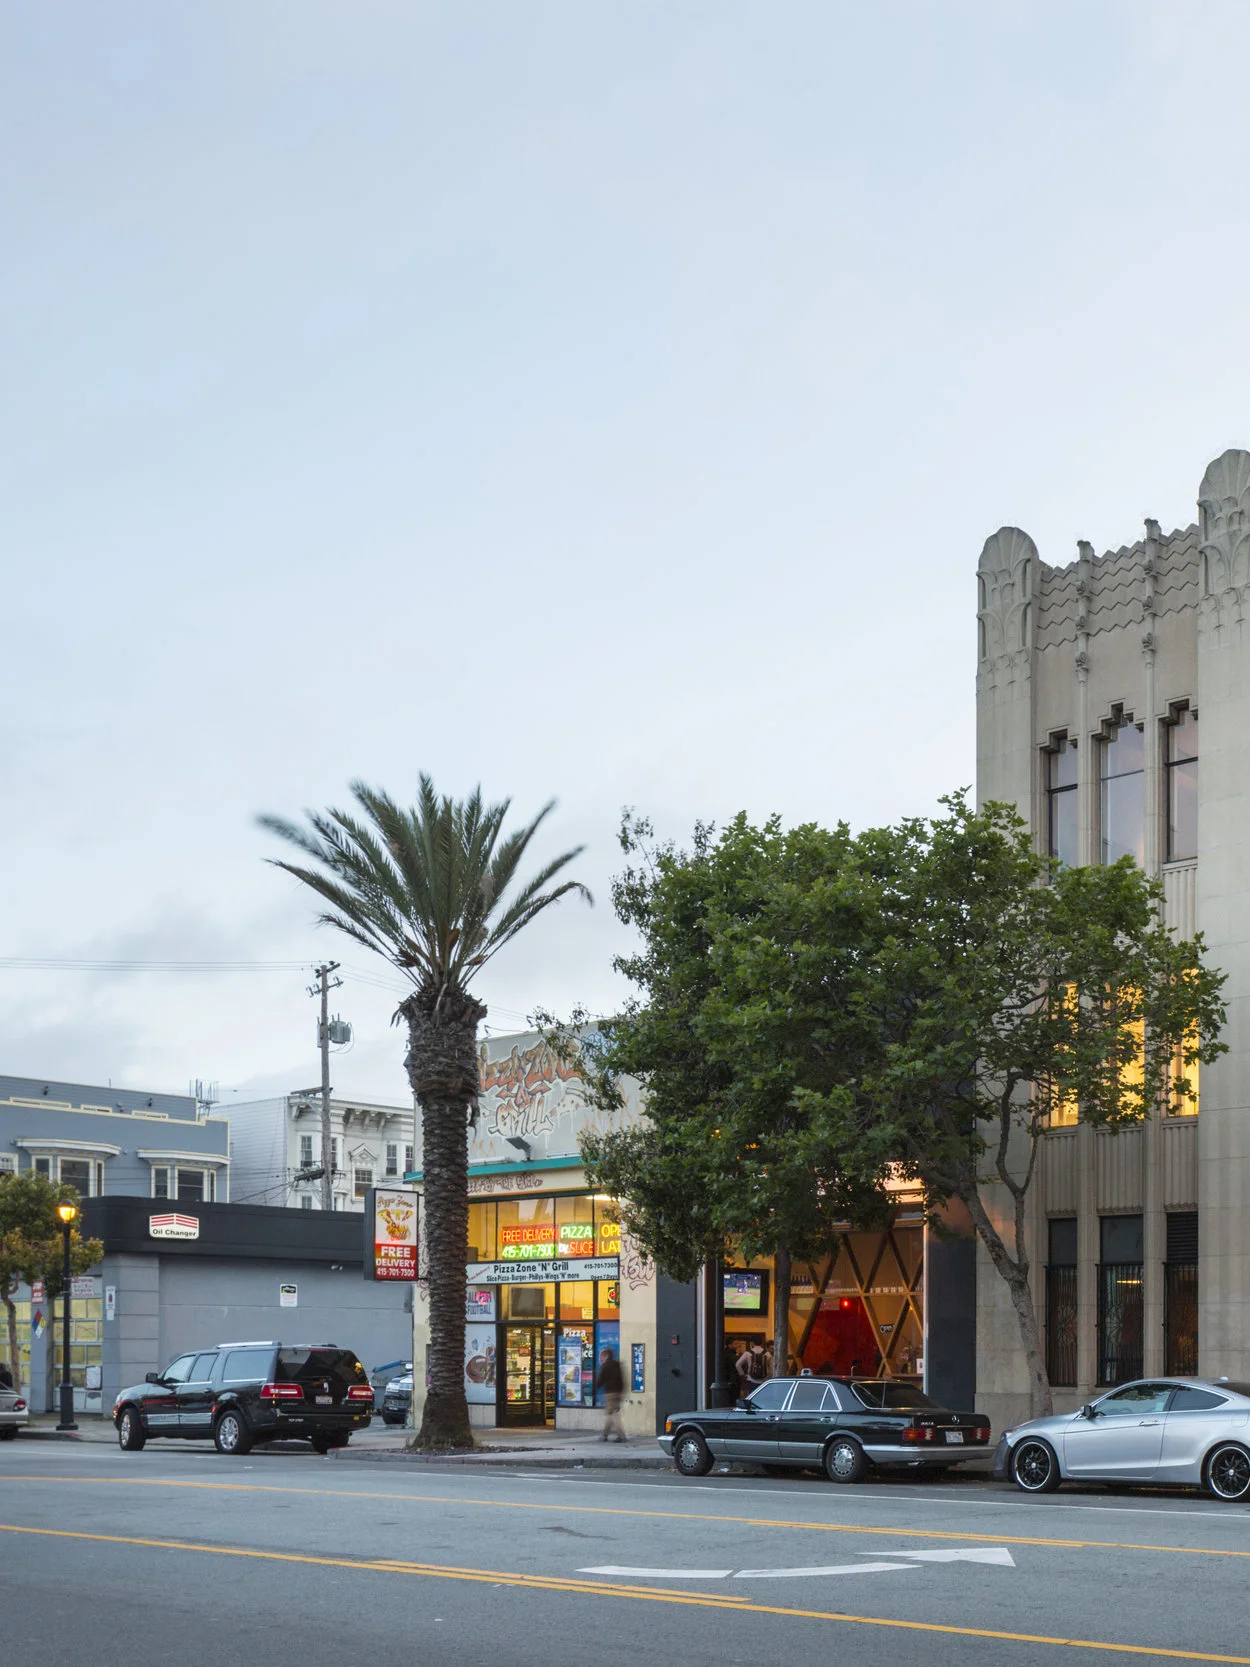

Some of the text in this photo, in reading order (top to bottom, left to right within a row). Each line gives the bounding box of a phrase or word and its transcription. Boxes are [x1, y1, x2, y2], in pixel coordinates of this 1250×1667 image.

[476, 1043, 523, 1092] IZZA
[165, 1229, 196, 1237] Changer
[503, 1227, 554, 1242] FREE DELIVERY
[561, 1226, 592, 1238] PIZZA
[381, 1245, 411, 1257] FREE
[569, 1241, 593, 1254] SLICE
[376, 1258, 415, 1267] DELIVERY
[494, 1264, 515, 1274] Pizza
[516, 1263, 537, 1273] Zone
[552, 1261, 569, 1271] Grill
[563, 1327, 586, 1338] Pizza
